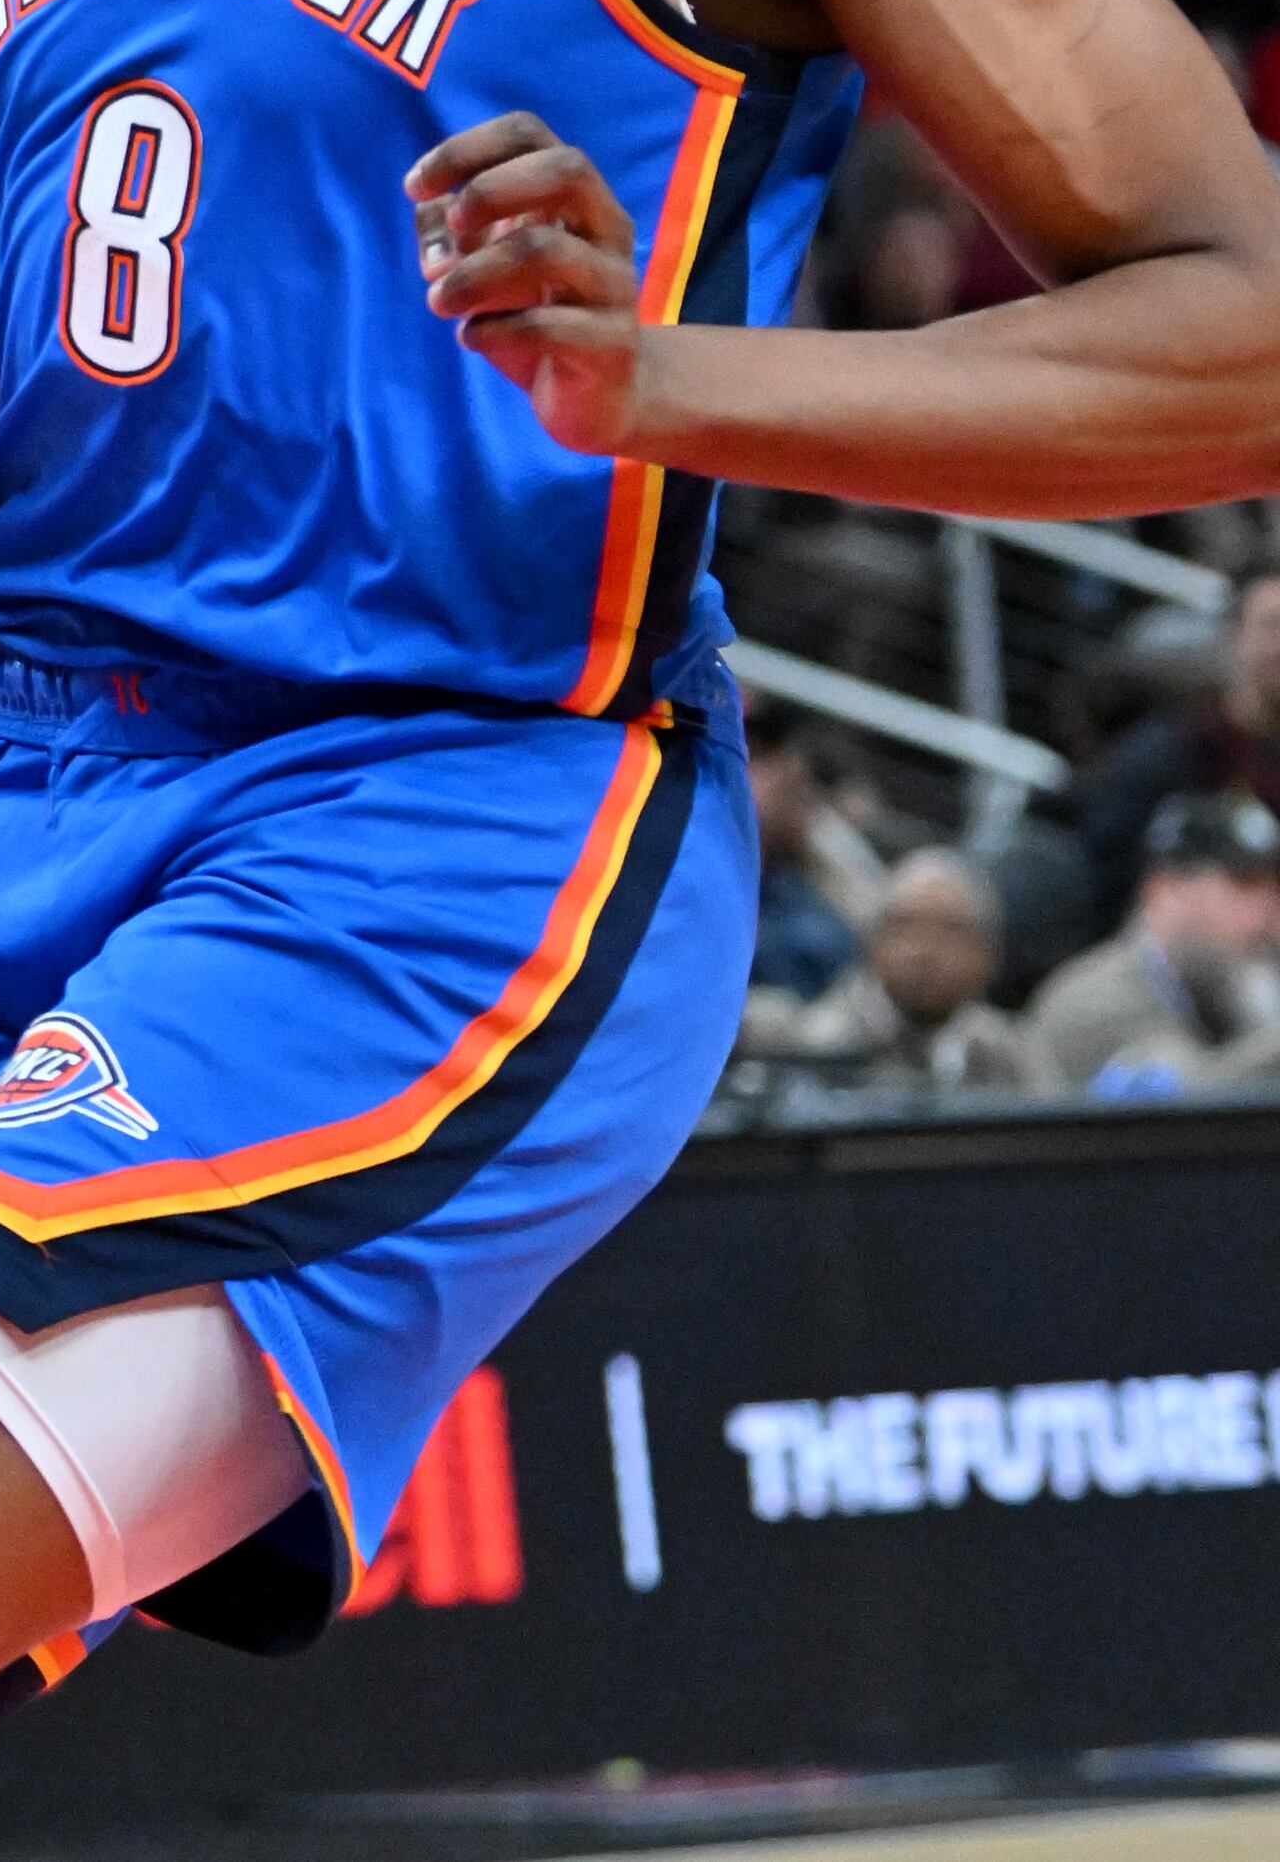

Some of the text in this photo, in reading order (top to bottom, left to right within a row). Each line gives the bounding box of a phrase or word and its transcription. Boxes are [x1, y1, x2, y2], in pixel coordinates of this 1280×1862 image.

[58, 79, 203, 386] 8
[723, 1391, 928, 1523] THE
[929, 1370, 1263, 1511] FUTURE
